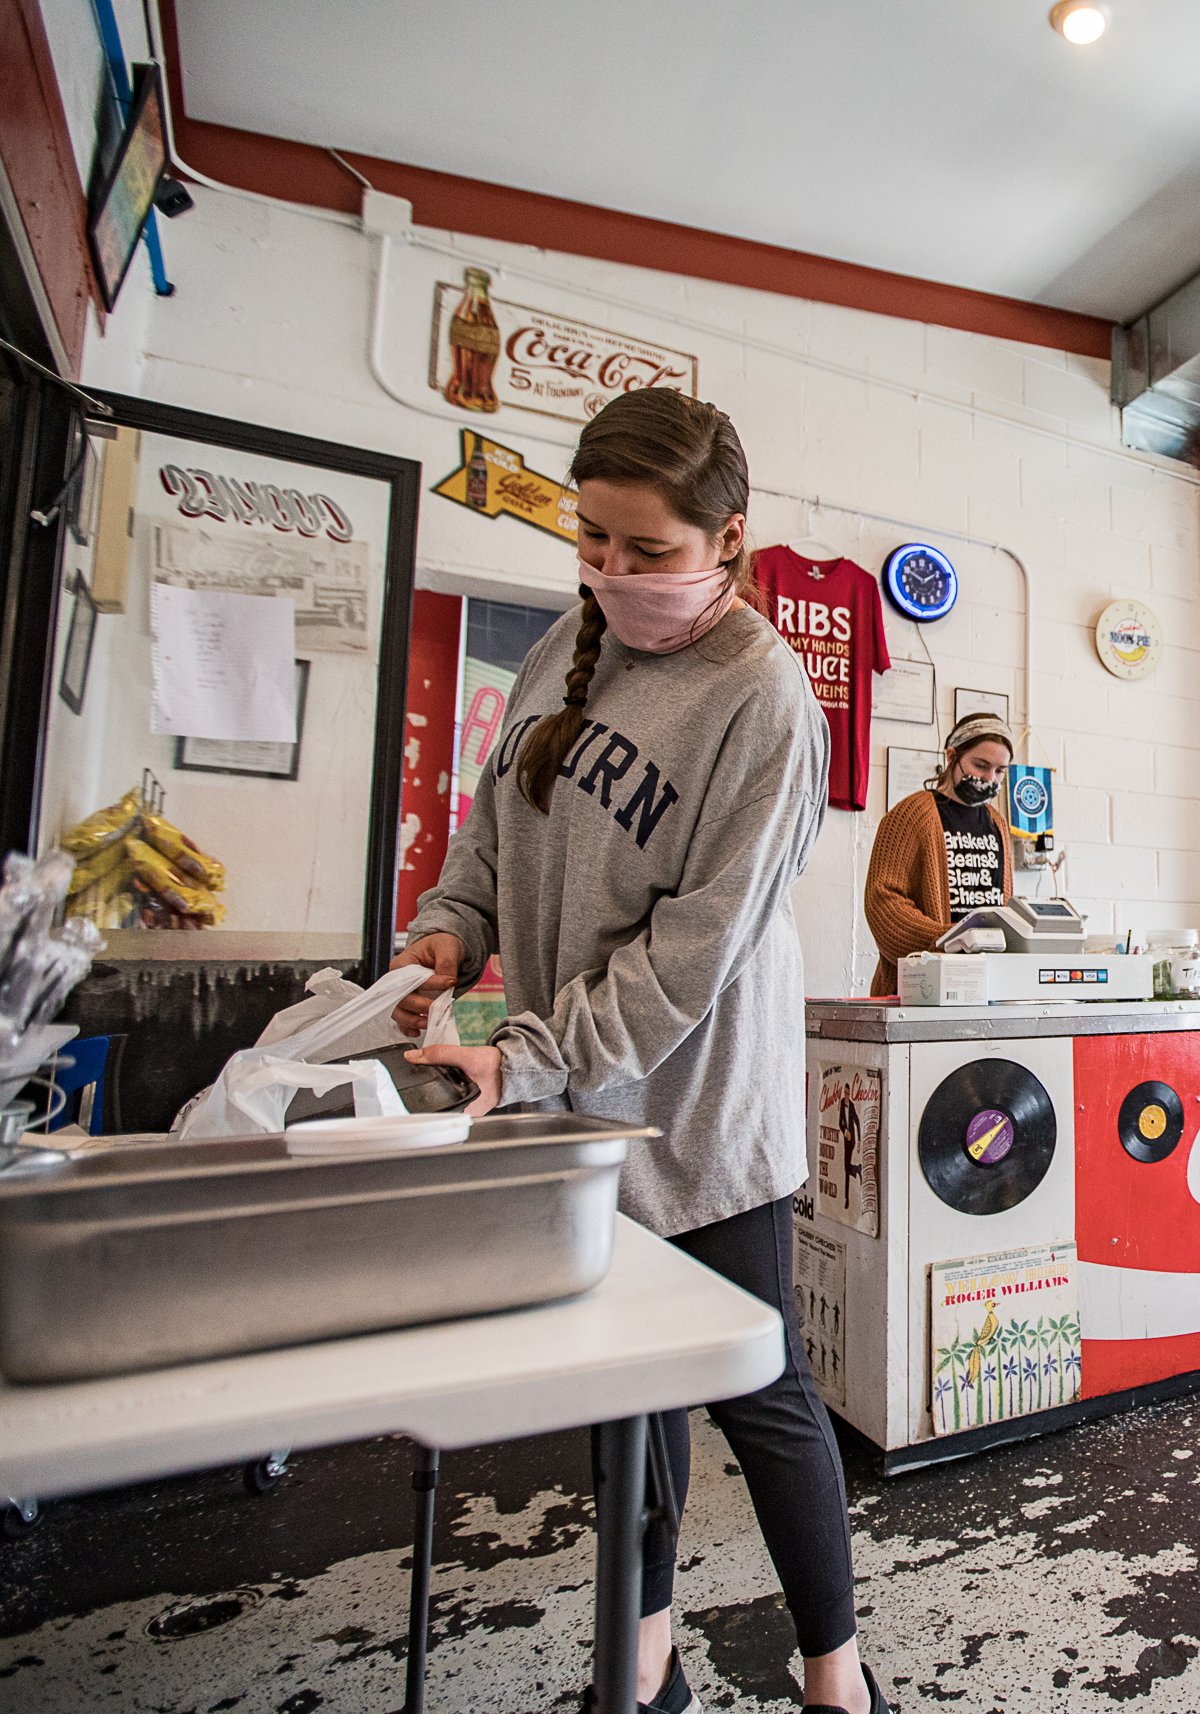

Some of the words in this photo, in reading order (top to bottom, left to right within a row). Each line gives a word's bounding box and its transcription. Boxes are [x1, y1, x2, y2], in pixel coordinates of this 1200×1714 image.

[505, 326, 687, 393] Coca-Col
[777, 595, 851, 642] RIBS
[812, 639, 850, 658] HANDS
[814, 683, 850, 700] VEINS
[948, 869, 993, 886] Slaw&
[792, 1193, 814, 1222] cold
[944, 1288, 997, 1306] ROGER
[1001, 1276, 1069, 1296] WILLIAMS
[945, 1271, 1020, 1295] YELLOW
[1025, 1263, 1069, 1281] BIRD
